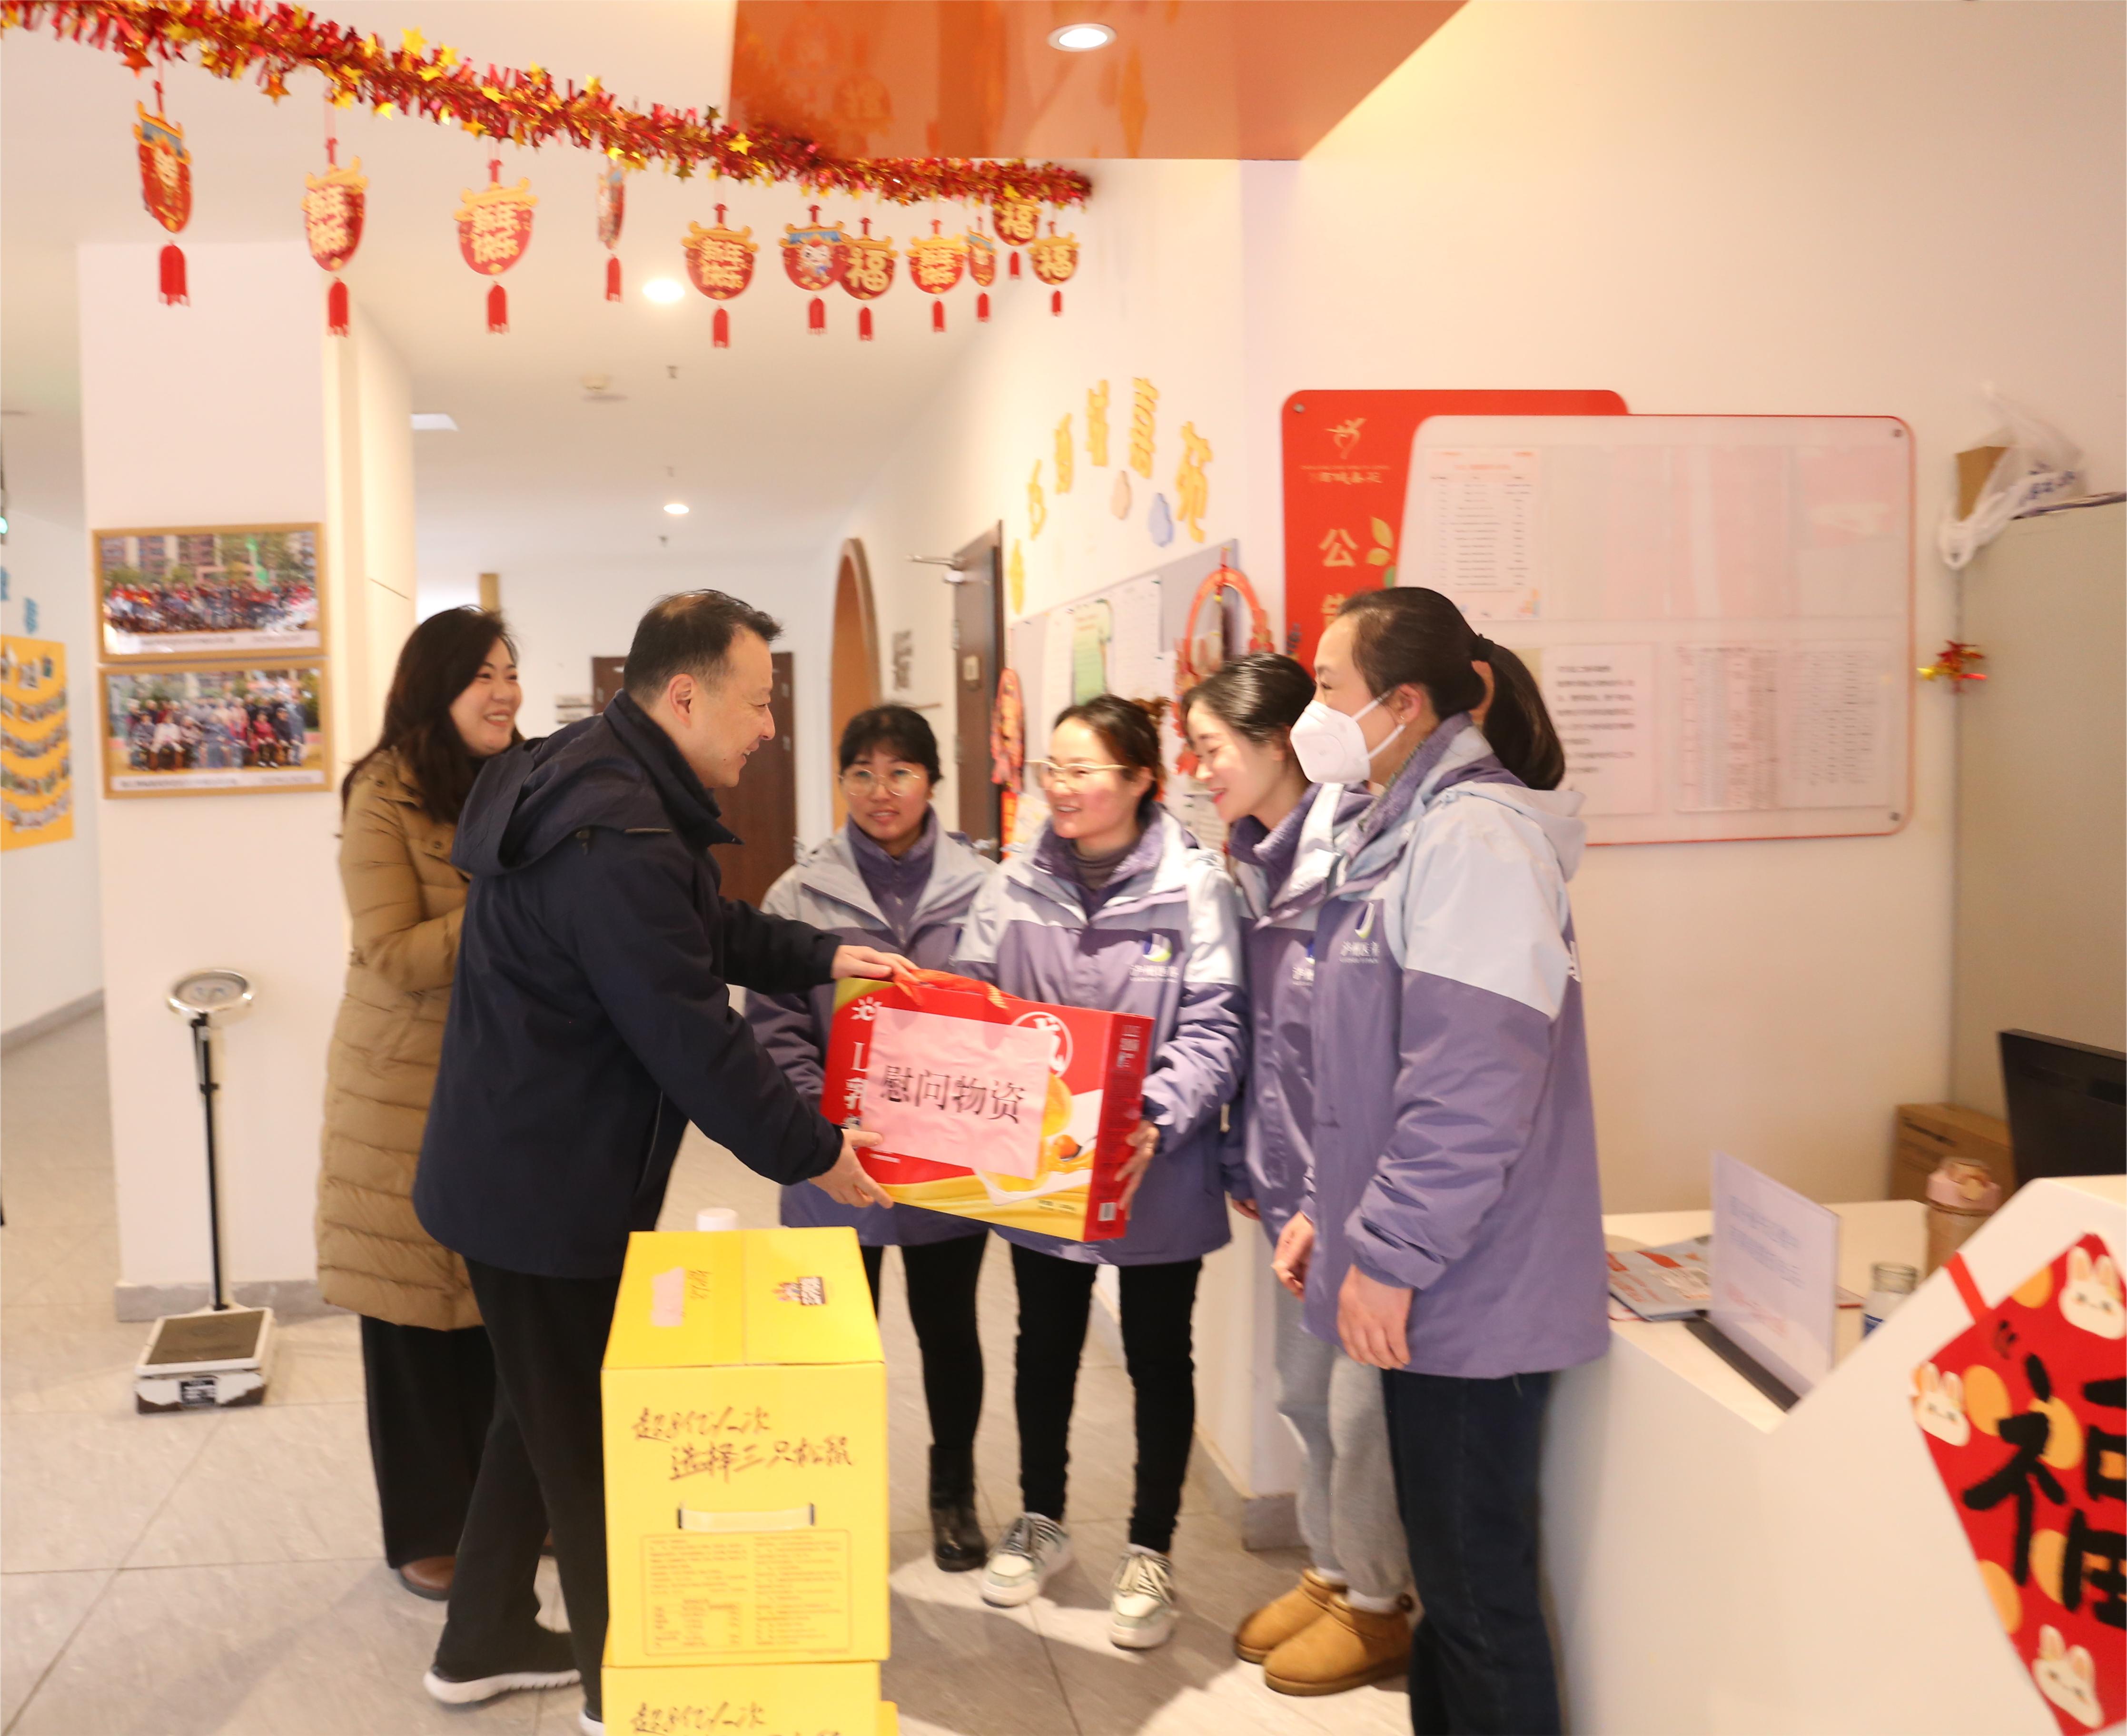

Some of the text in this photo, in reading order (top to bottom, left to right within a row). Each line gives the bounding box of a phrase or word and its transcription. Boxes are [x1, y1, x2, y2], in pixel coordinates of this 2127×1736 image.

[999, 202, 1034, 238] 福
[845, 247, 890, 292] 福
[1038, 245, 1074, 278] 福
[880, 1065, 1026, 1124] 慰问物资
[669, 1435, 854, 1484] 选择三只松鼠
